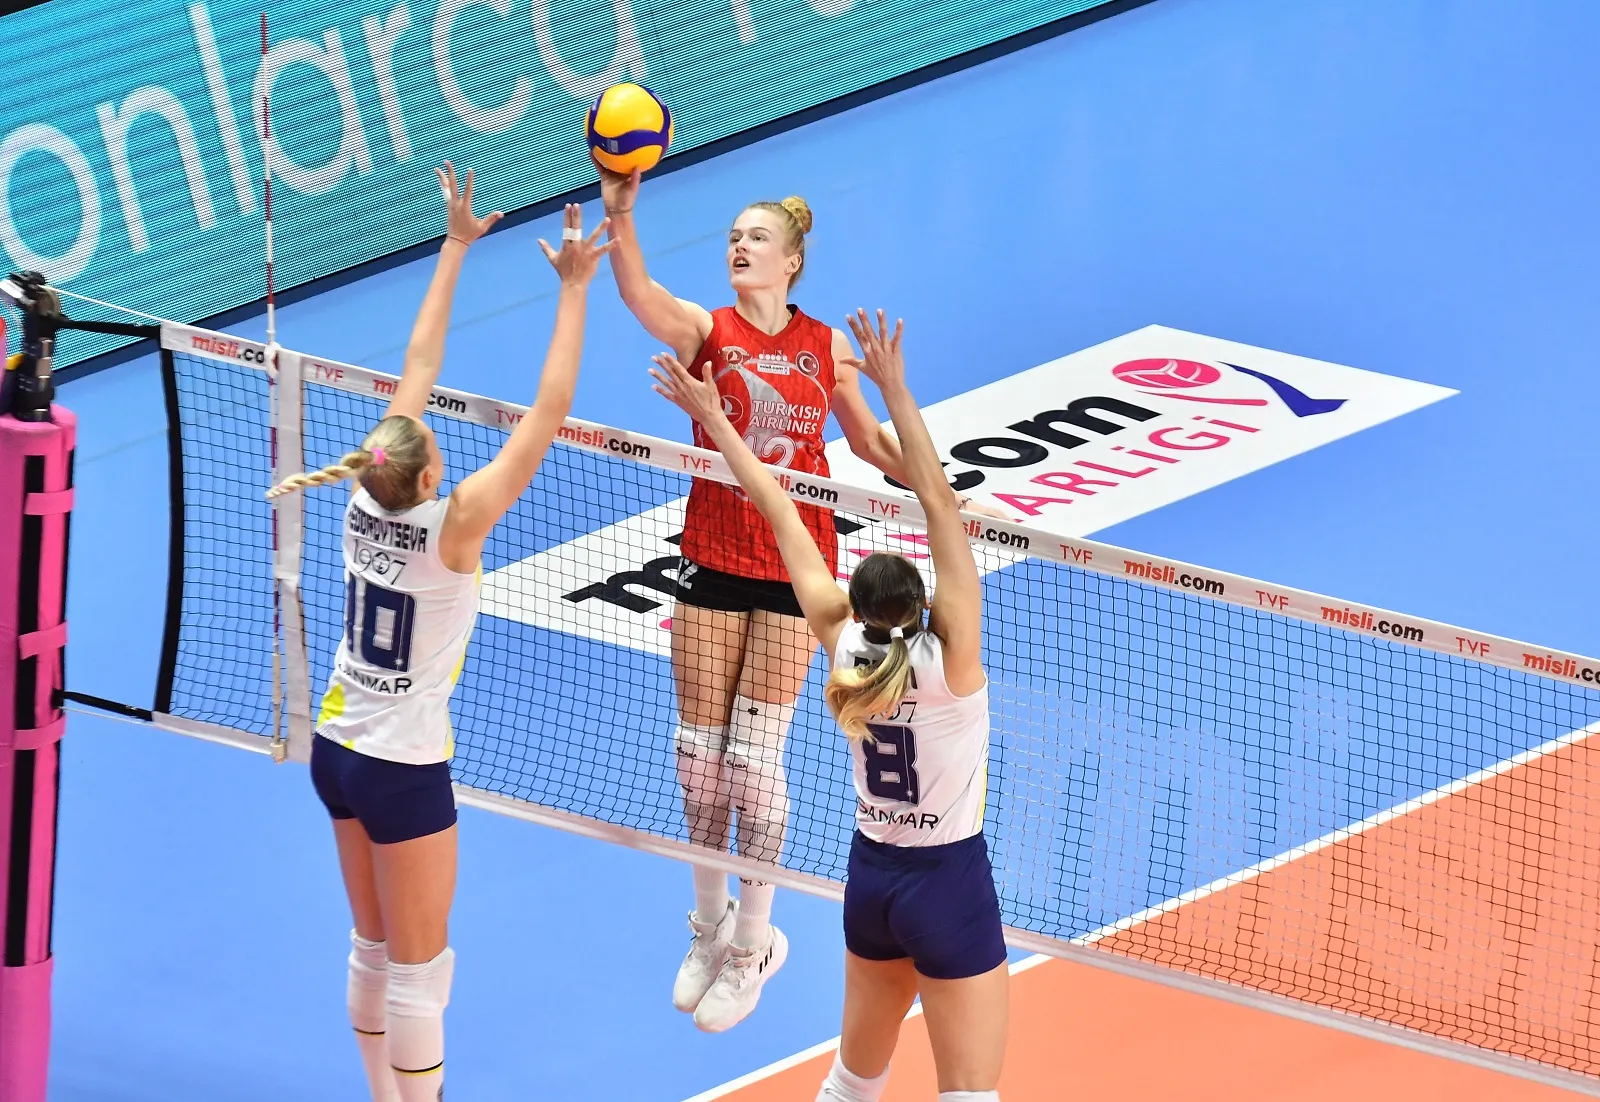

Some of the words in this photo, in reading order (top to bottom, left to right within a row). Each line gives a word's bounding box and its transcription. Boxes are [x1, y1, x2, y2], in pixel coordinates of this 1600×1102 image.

[749, 415, 818, 435] AIRLINES
[753, 400, 822, 421] TURKISH
[192, 335, 264, 363] misli.co
[313, 363, 344, 382] TVF
[558, 426, 651, 459] misli.com
[680, 453, 712, 473] TVF
[776, 473, 838, 503] li.com
[868, 498, 900, 519] TVF
[1060, 544, 1092, 565] TVF
[1123, 559, 1225, 596] misli.com
[1255, 590, 1289, 611] TVF
[1321, 606, 1424, 643] misli.com
[1455, 636, 1490, 657] TVF
[861, 723, 920, 808] 8
[857, 796, 939, 829] SANMAR
